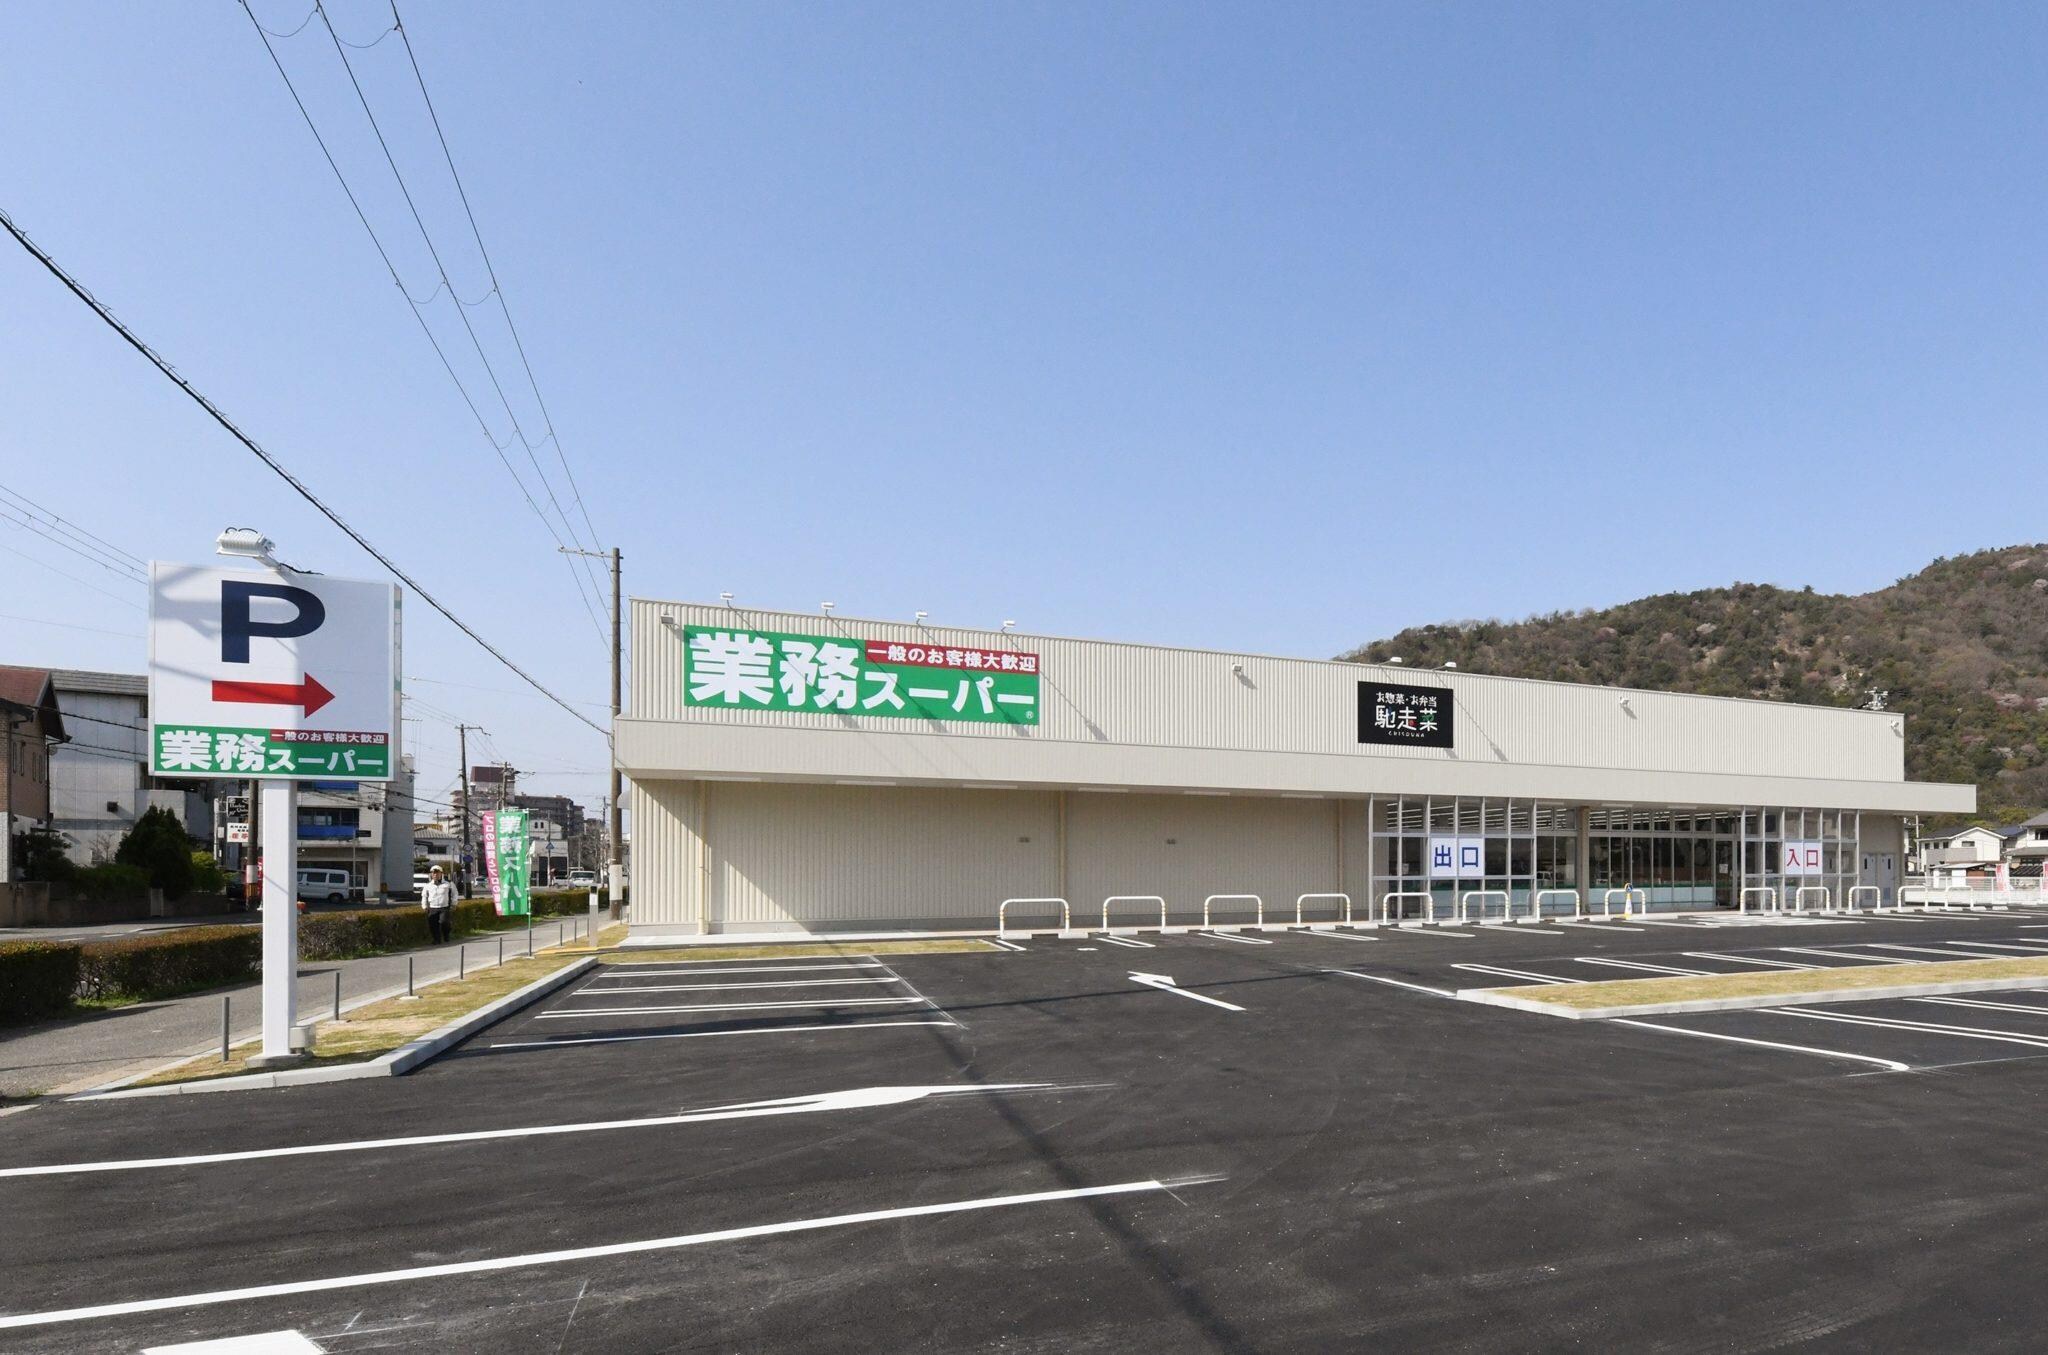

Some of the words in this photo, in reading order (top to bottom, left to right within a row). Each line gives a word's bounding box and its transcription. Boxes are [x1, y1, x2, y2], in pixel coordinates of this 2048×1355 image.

[221, 580, 326, 664] P
[868, 645, 1036, 672] 一般のお客様大歓迎
[689, 632, 1034, 714] 業務スーパー
[1375, 705, 1438, 731] 馳走菜
[160, 730, 383, 772] 業務スーパー
[271, 732, 385, 744] 一般のお客様大歓迎
[1434, 845, 1479, 868] 出口
[1787, 849, 1818, 867] 入口
